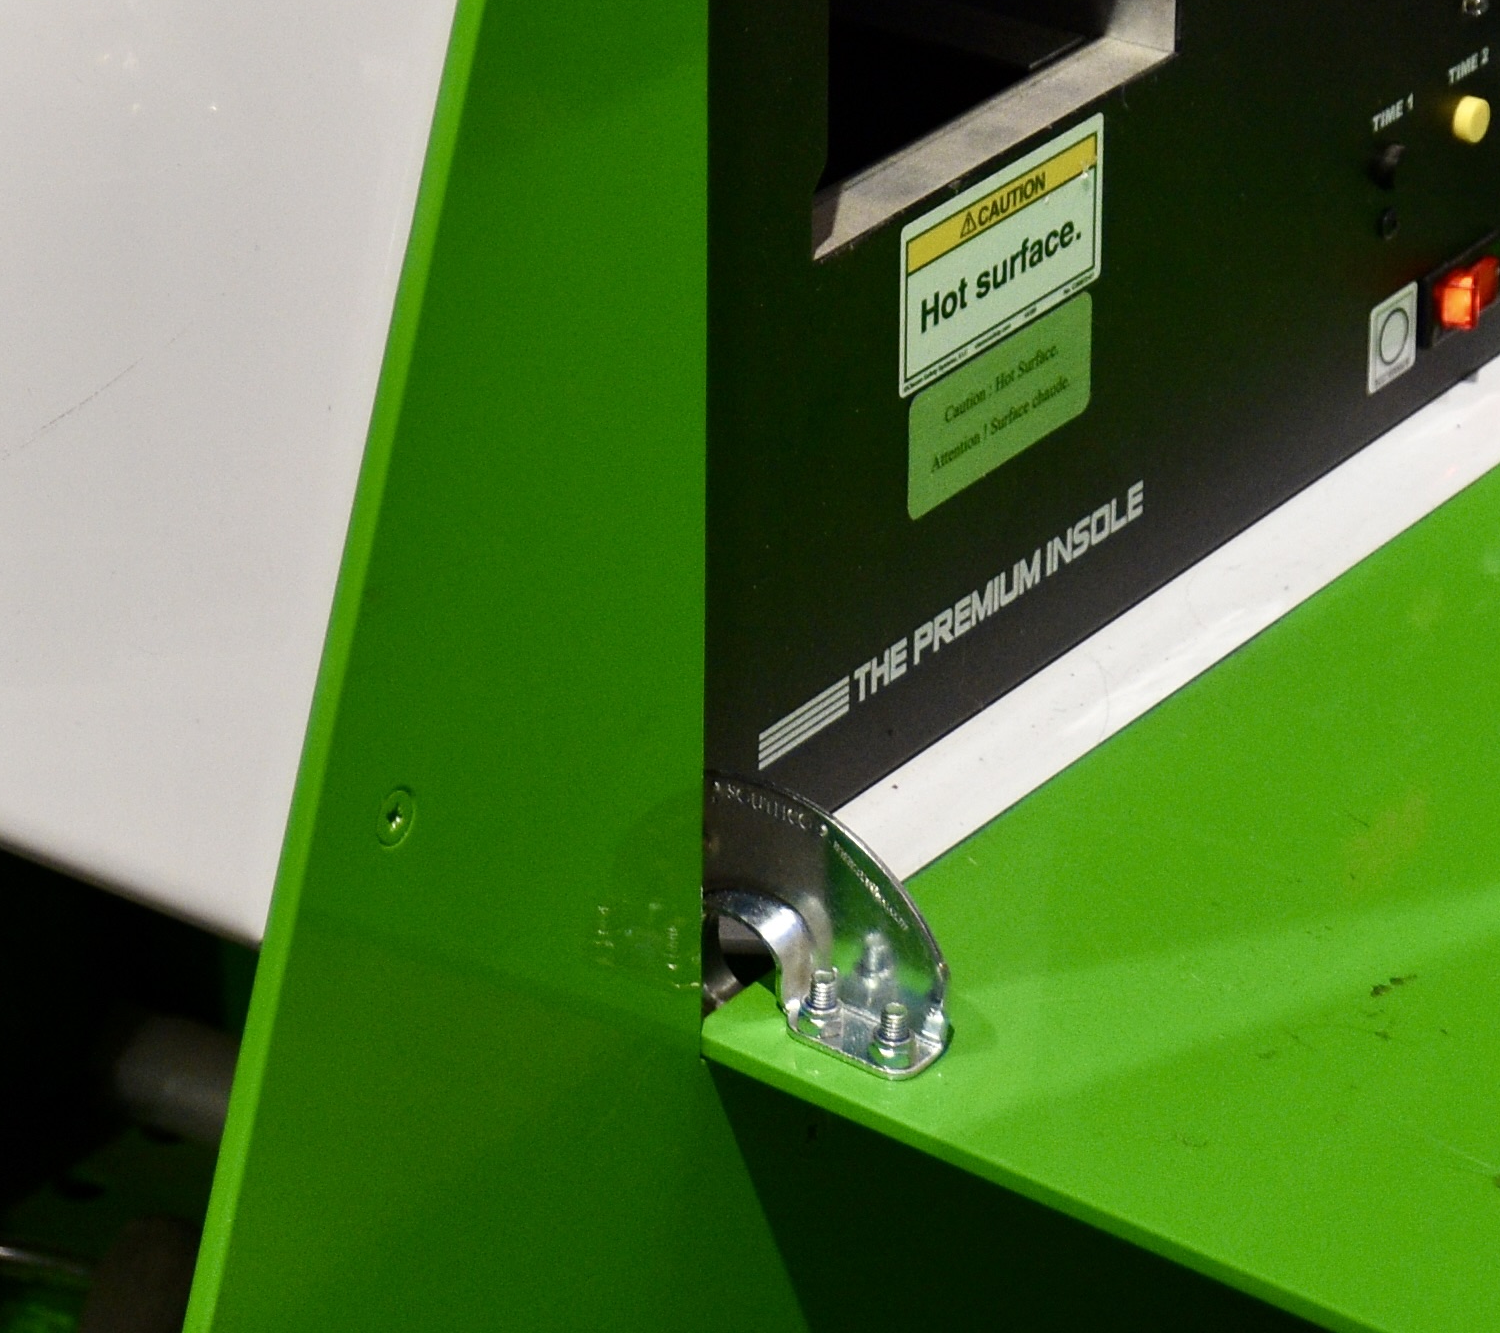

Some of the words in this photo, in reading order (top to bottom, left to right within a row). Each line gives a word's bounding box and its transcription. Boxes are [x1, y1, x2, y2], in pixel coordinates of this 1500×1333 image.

[1447, 51, 1479, 85] TIME
[1479, 45, 1490, 67] 2
[1371, 97, 1404, 133] TIME
[977, 171, 1047, 226] CAUTION
[920, 277, 969, 334] Hot
[975, 219, 1083, 300] surface.
[943, 388, 987, 424] Caution
[995, 368, 1016, 393] Hot
[929, 432, 982, 474] Attention
[990, 402, 1031, 435] Surface
[853, 637, 908, 703] THE
[913, 547, 1042, 666] PREMIUM
[1046, 479, 1145, 578] INSOLE
